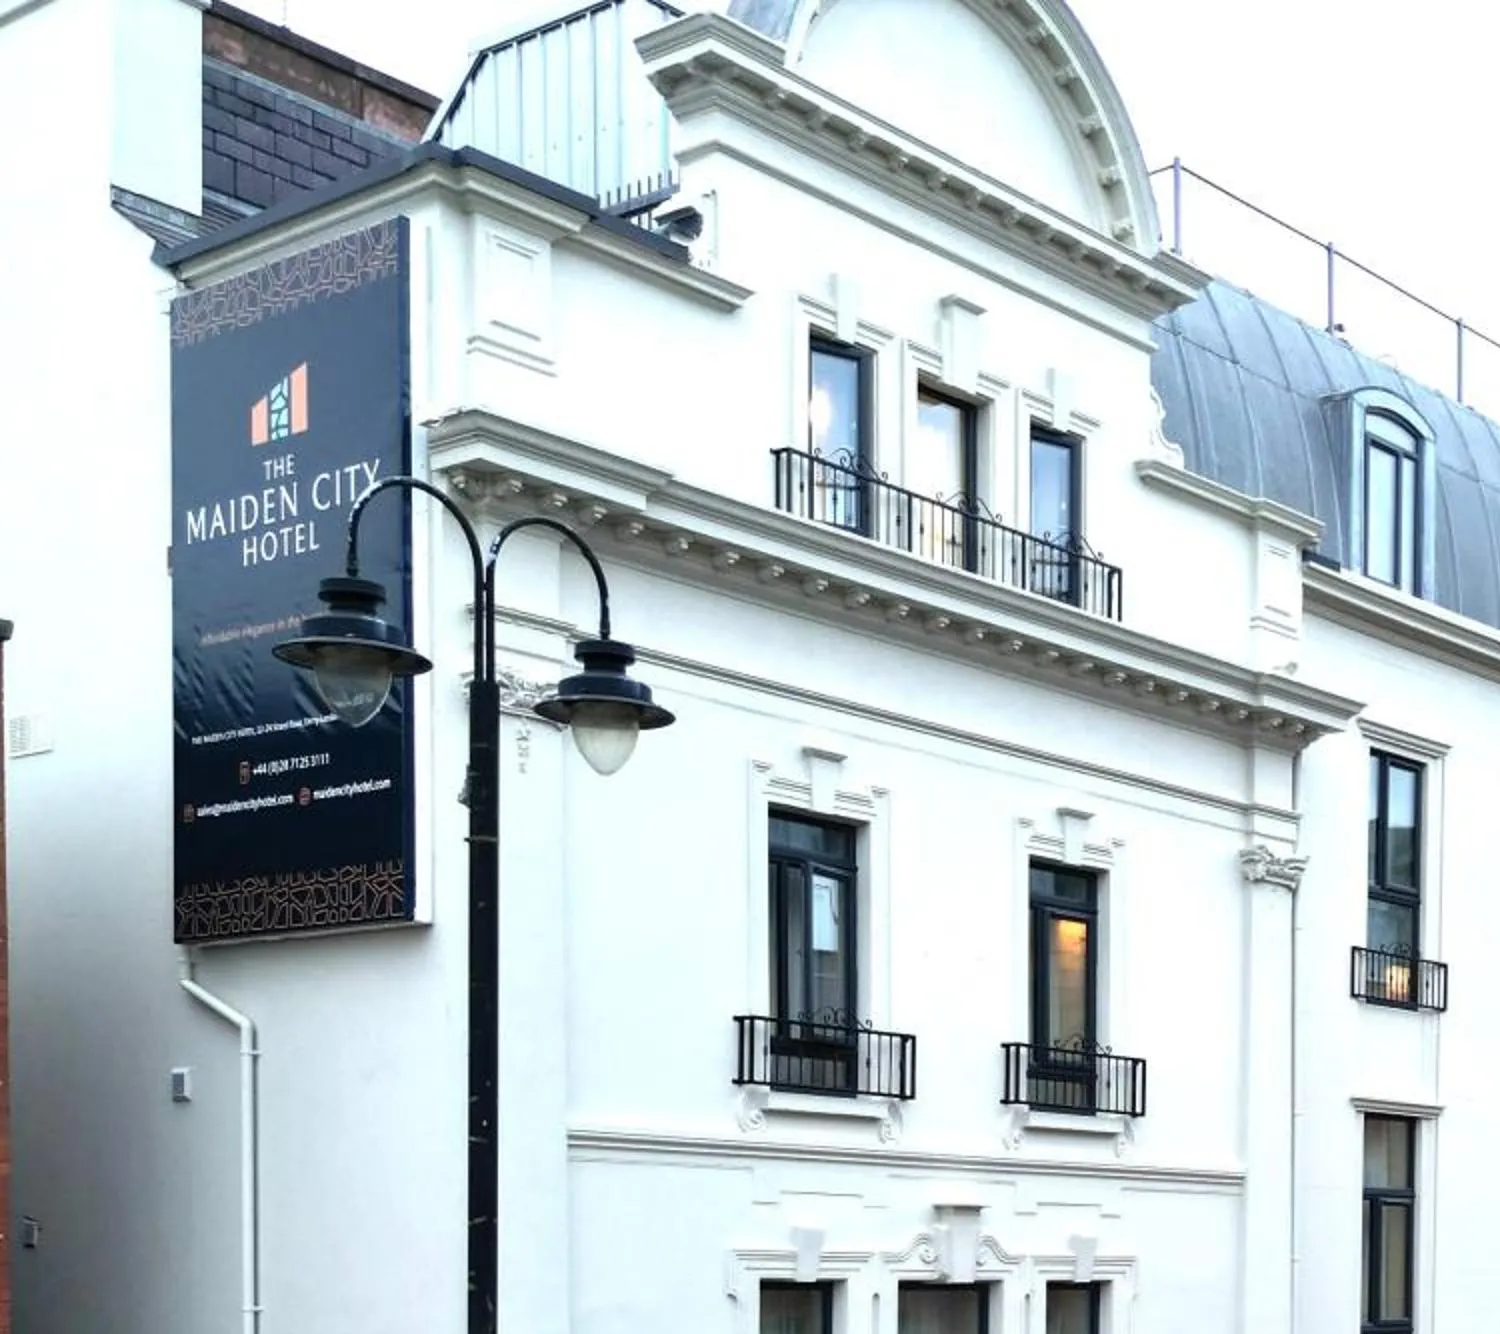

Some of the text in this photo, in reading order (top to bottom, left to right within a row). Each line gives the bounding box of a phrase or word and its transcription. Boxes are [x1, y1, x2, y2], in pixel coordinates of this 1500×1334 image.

[262, 453, 295, 481] THE
[186, 457, 380, 545] MAIDEN CITY
[242, 520, 320, 567] HOTEL
